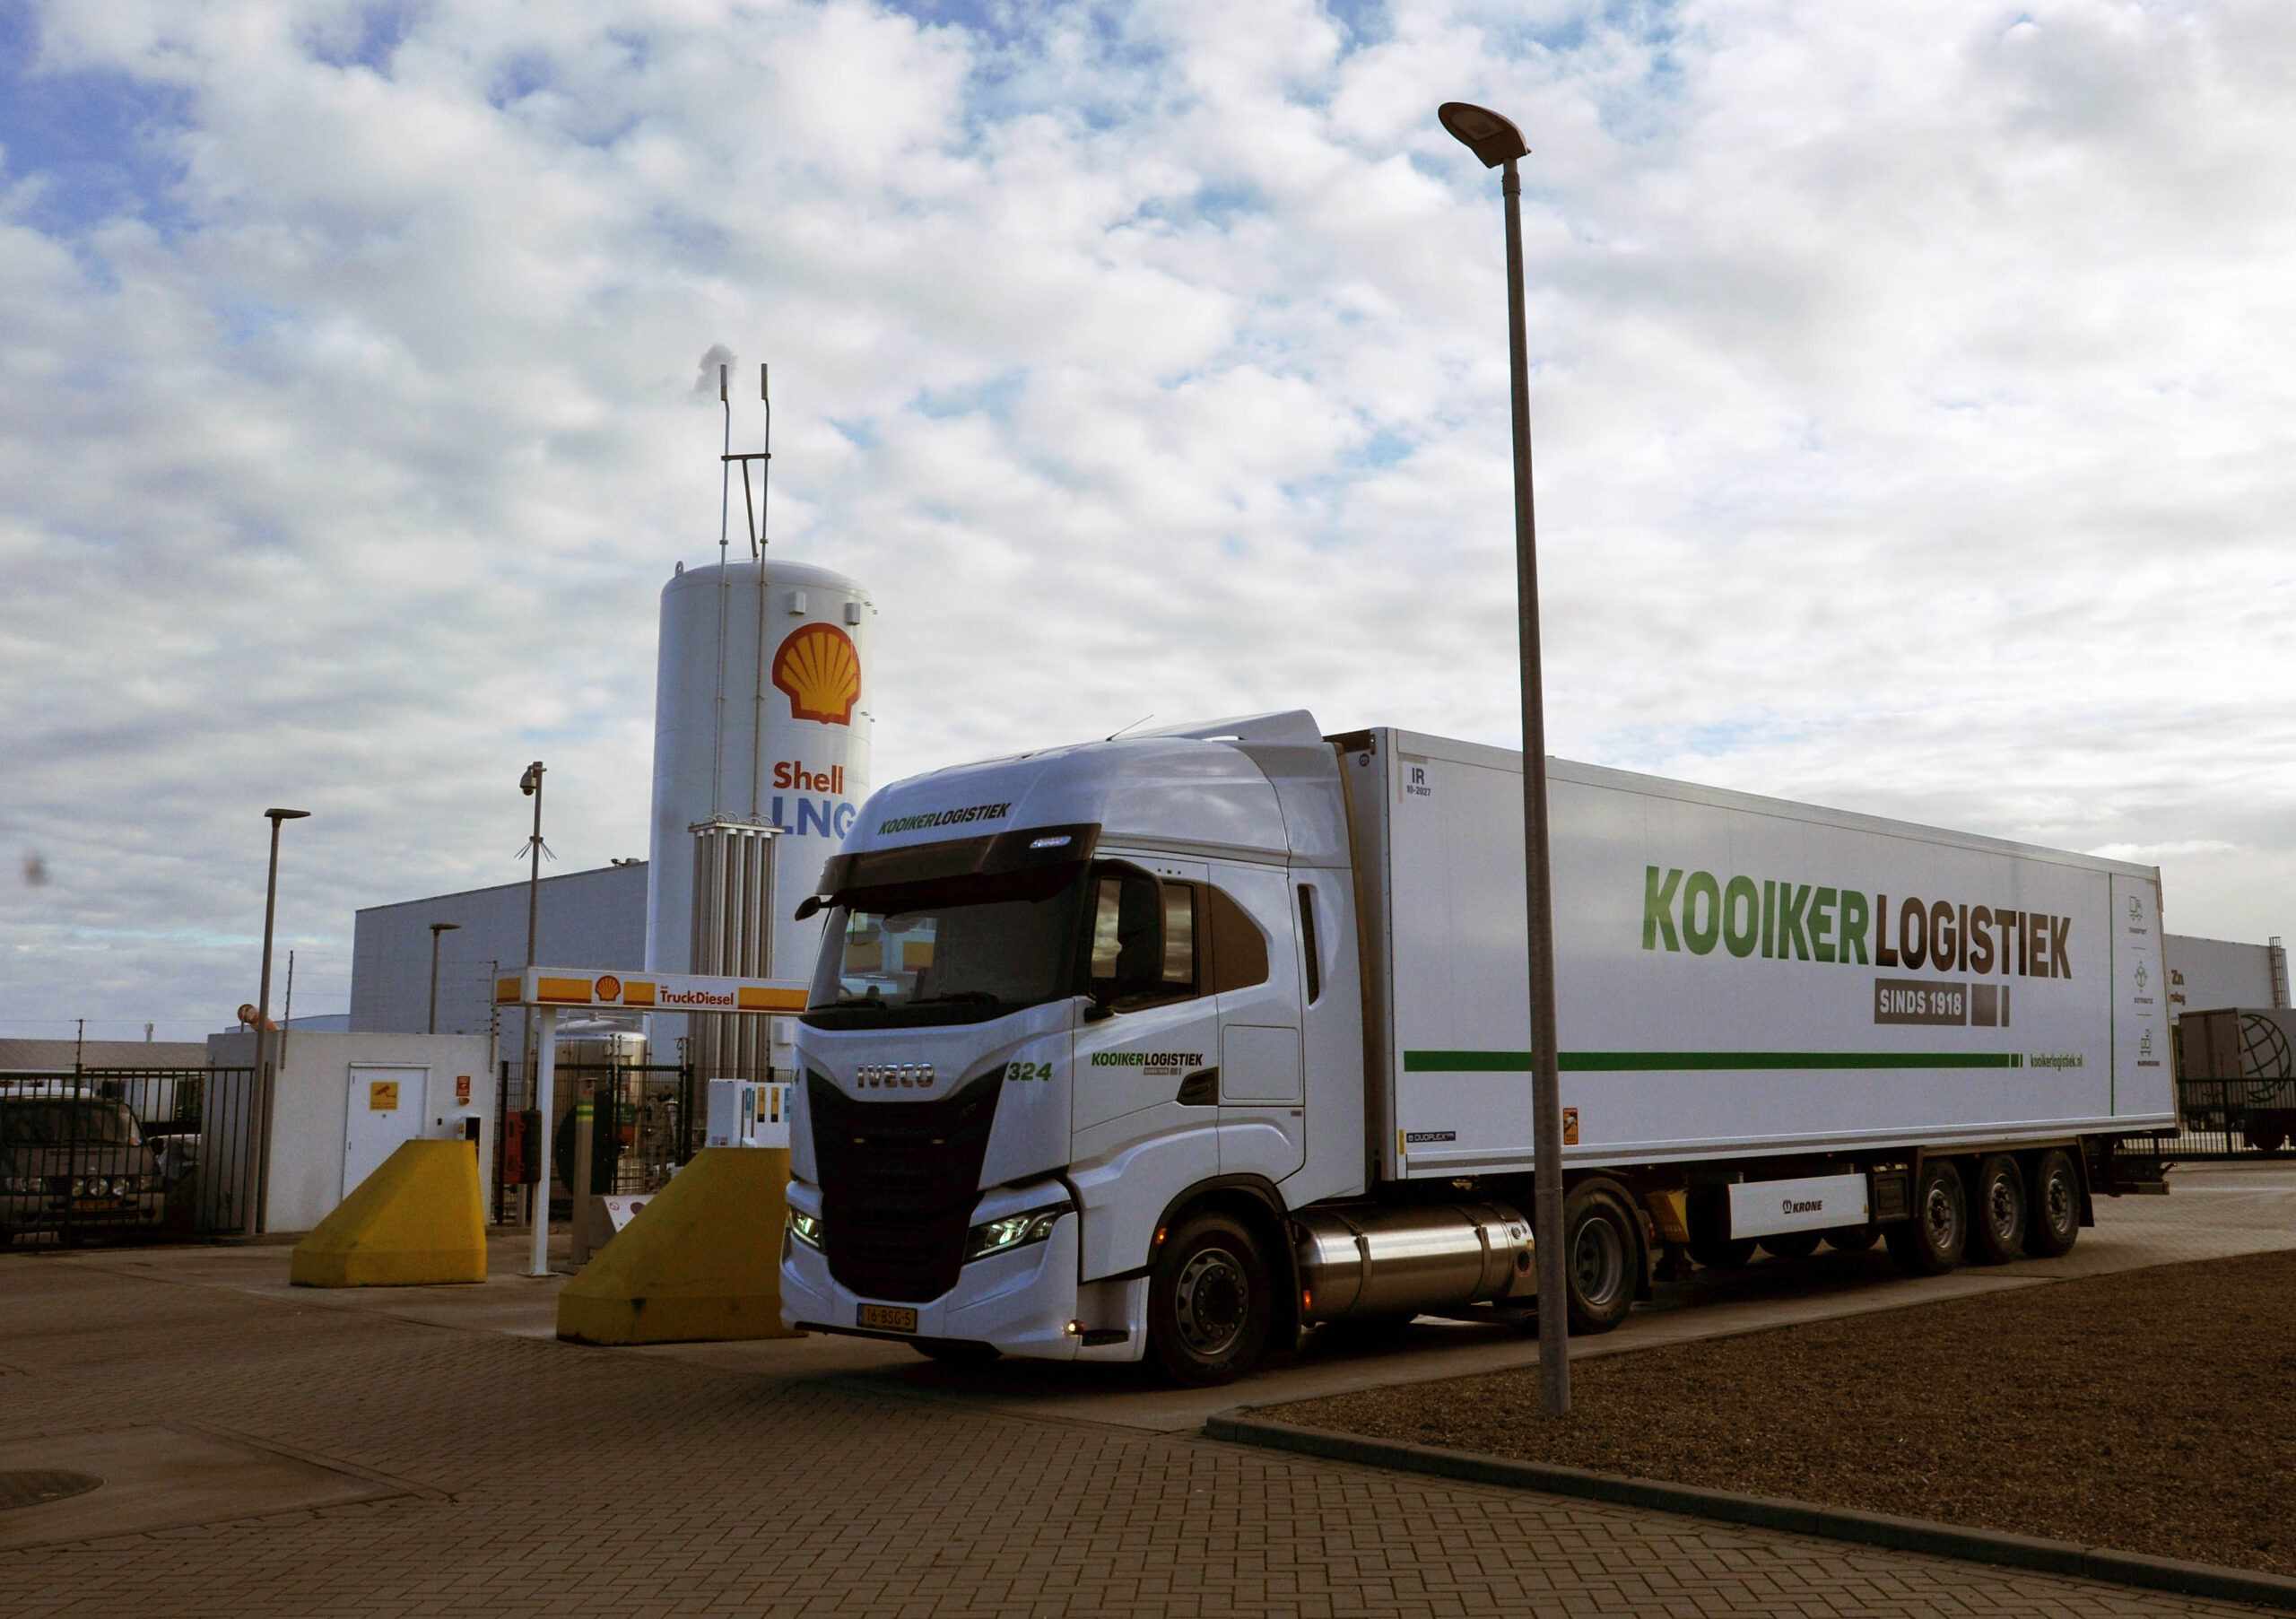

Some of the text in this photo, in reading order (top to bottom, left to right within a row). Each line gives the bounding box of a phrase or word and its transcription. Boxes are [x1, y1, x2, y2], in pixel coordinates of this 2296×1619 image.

[773, 761, 844, 795] Shell
[1412, 767, 1425, 785] IR
[1406, 785, 1431, 796] 10-2027
[772, 796, 856, 840] LNG
[877, 803, 1012, 836] KOOIKERLOGISTIEK
[1642, 865, 2073, 979] KOOIKERLOGISTIEK
[660, 990, 735, 1005] TruckDiesel
[1880, 989, 1961, 1015] SINDS 1918
[1091, 1052, 1204, 1066] KOOIKERLOGISTIEK
[857, 1062, 935, 1089] IVECO
[1007, 1062, 1052, 1082] 324
[1793, 1200, 1822, 1214] KRONE
